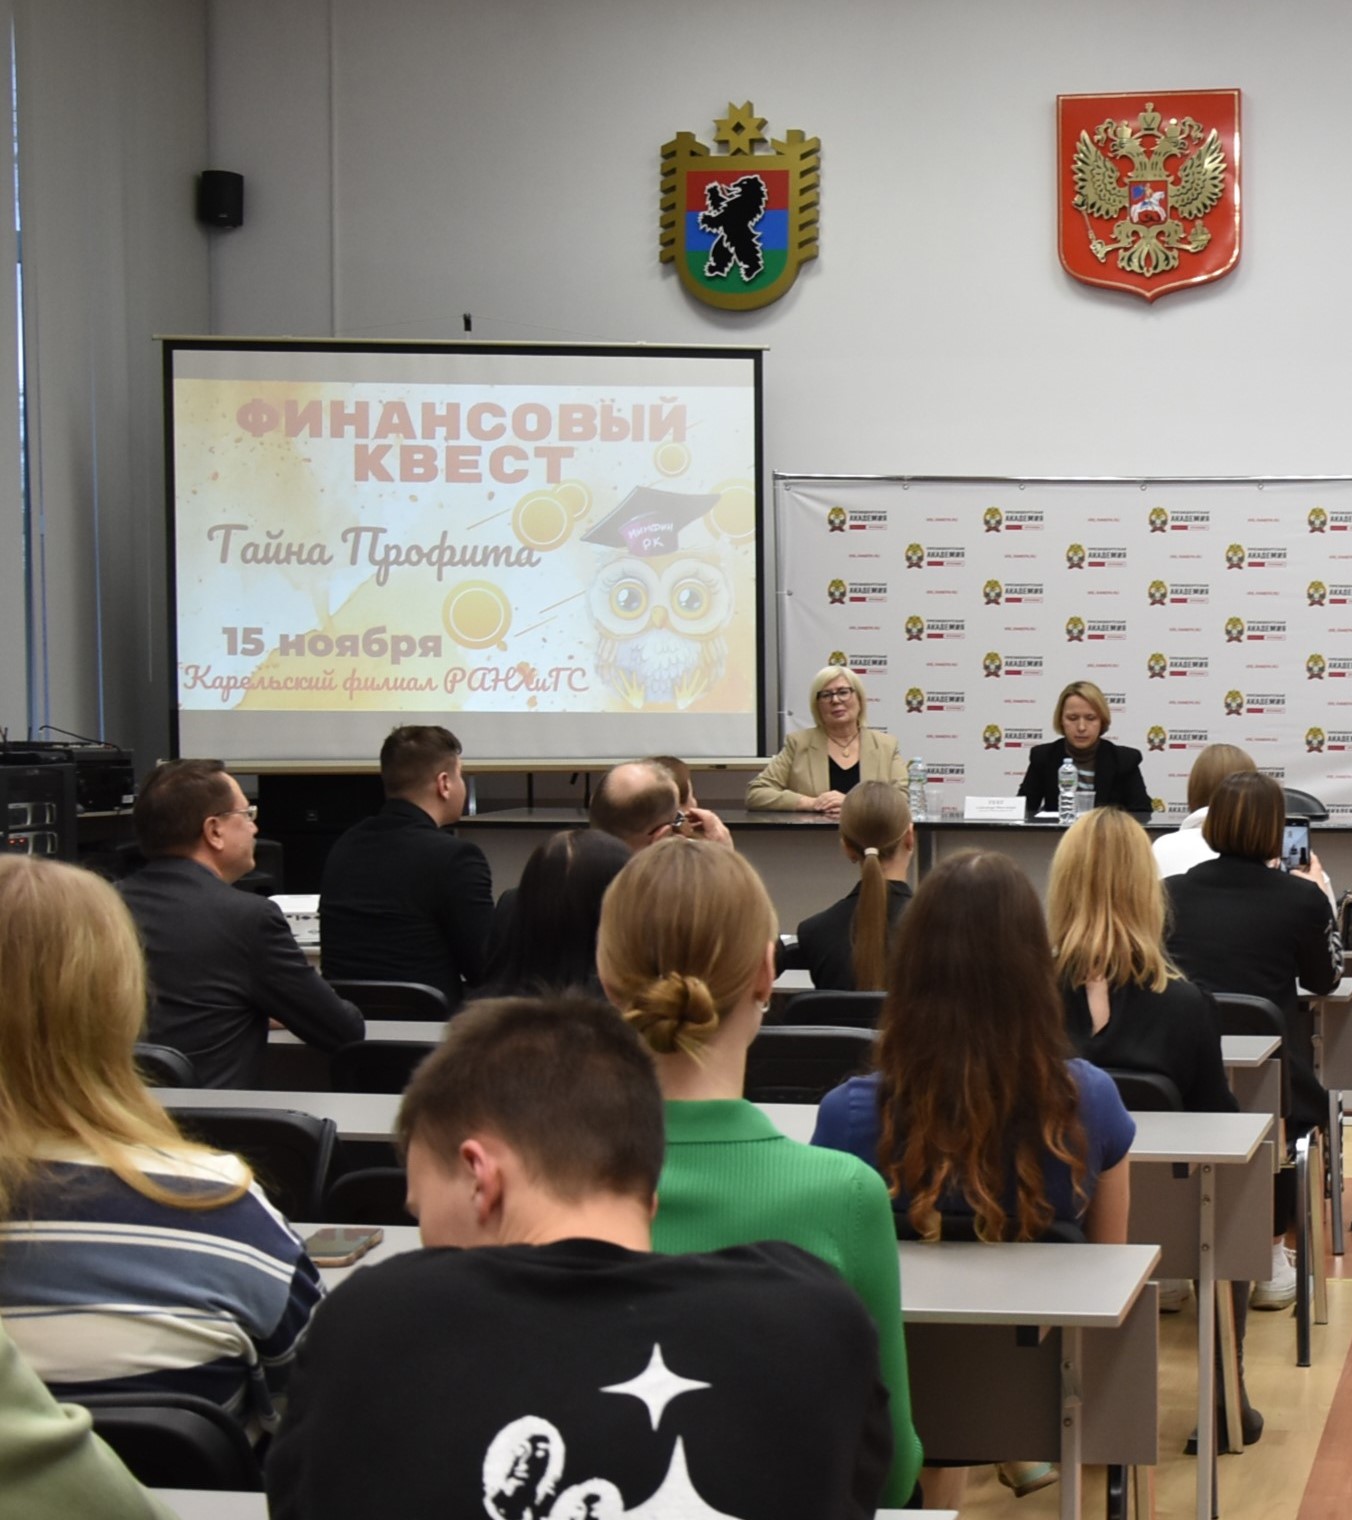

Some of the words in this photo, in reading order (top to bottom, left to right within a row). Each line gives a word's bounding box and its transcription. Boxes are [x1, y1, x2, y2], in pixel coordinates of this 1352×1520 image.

[236, 395, 687, 443] ФИНАНСОВЫЙ
[353, 444, 575, 484] КВЕСТ
[207, 523, 333, 566] Тайна
[341, 525, 542, 587] Профита
[222, 627, 264, 656] 15
[279, 625, 442, 665] ноября
[183, 665, 337, 701] Карельский
[343, 669, 438, 699] филиал
[444, 664, 589, 694] РАНХиГС
